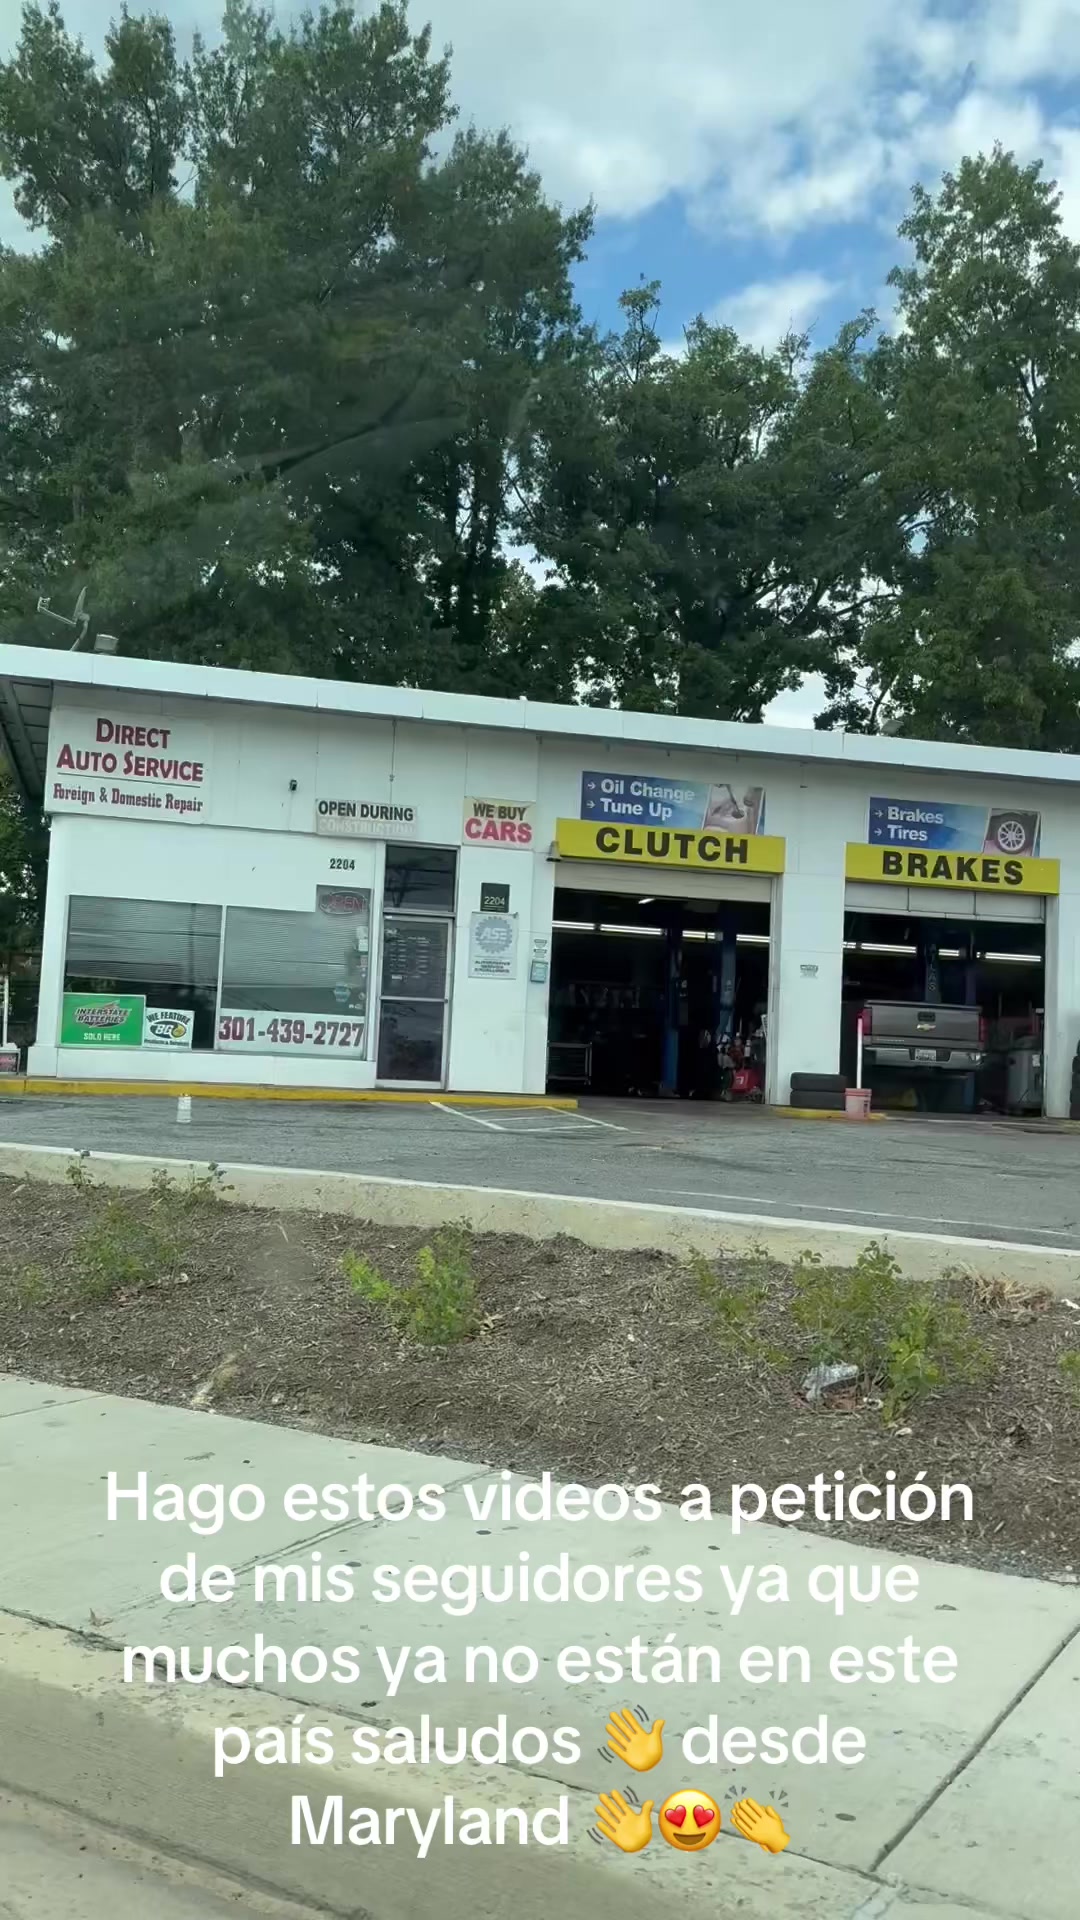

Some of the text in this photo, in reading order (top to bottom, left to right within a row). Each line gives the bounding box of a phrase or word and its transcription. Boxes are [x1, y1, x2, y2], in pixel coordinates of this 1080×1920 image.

[96, 717, 171, 749] DIRECT
[56, 743, 204, 782] AUTO SERVICE
[53, 783, 203, 814] Foreign & Domestic Repair
[600, 778, 696, 802] Oil Change
[318, 800, 414, 821] OPEN DURING
[473, 803, 527, 821] WE BUY
[600, 798, 673, 821] Tune Up
[887, 806, 944, 825] Brakes
[465, 817, 533, 844] CARS
[887, 824, 928, 841] Tires
[595, 827, 749, 864] CLUTCH
[329, 857, 355, 871] 2204
[882, 850, 1024, 886] BRAKES
[484, 896, 505, 906] 2204
[480, 927, 507, 940] ASE
[146, 1012, 159, 1023] WE
[83, 1032, 121, 1041] SOLD HERE
[218, 1015, 365, 1047] 301-439-2727
